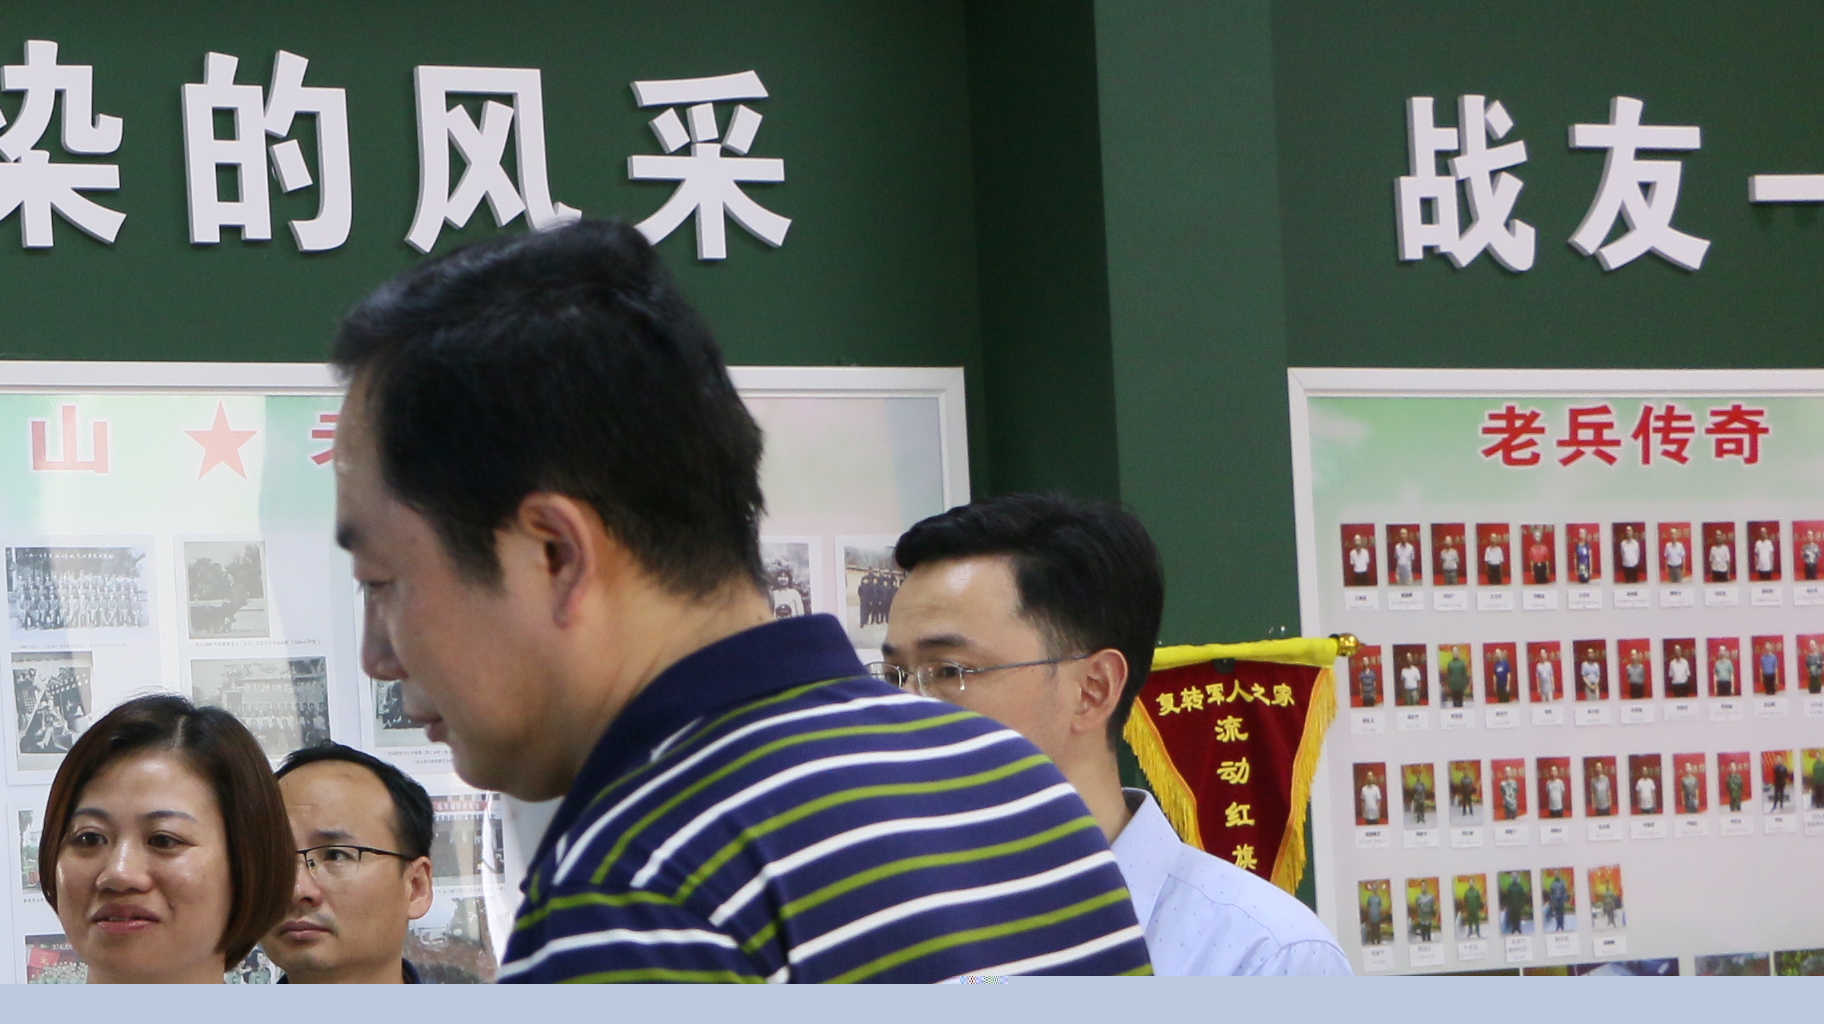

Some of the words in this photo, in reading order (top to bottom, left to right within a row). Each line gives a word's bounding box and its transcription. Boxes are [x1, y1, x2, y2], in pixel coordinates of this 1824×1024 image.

[1480, 404, 1770, 467] 老兵传奇
[1155, 679, 1295, 717] 复转军人之家
[1214, 715, 1258, 871] 流动红旗
